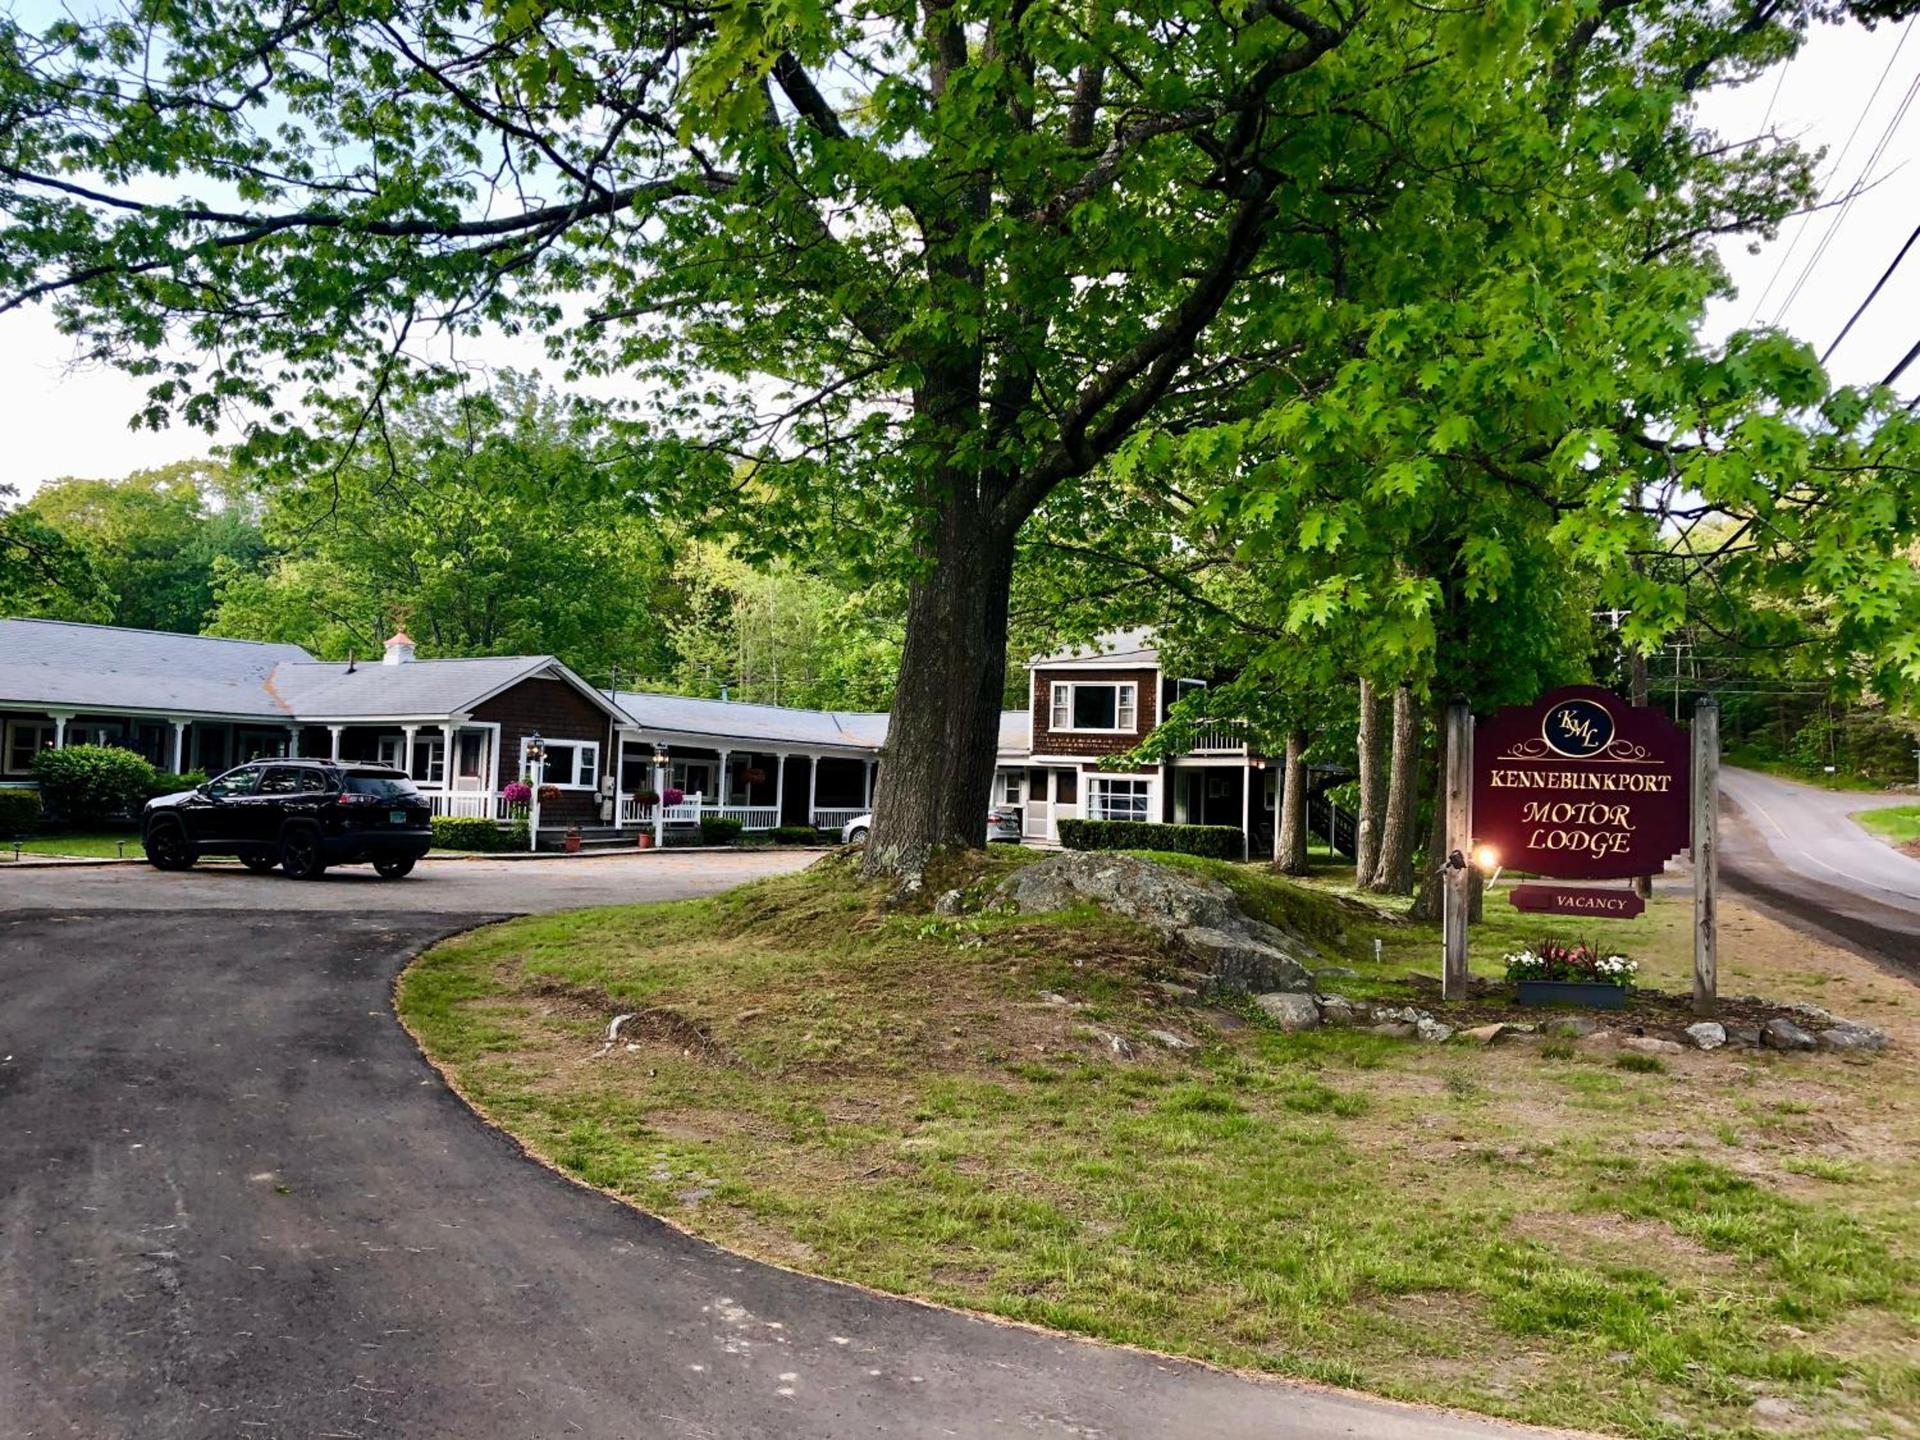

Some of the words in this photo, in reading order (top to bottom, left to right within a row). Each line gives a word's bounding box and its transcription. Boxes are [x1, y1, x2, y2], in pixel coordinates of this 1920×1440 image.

[1557, 710, 1599, 747] KML
[1490, 769, 1672, 792] KENNEBUNKPORT
[1522, 801, 1636, 831] MOTOR
[1527, 828, 1631, 859] LODGE
[1556, 895, 1628, 910] VACANCY
